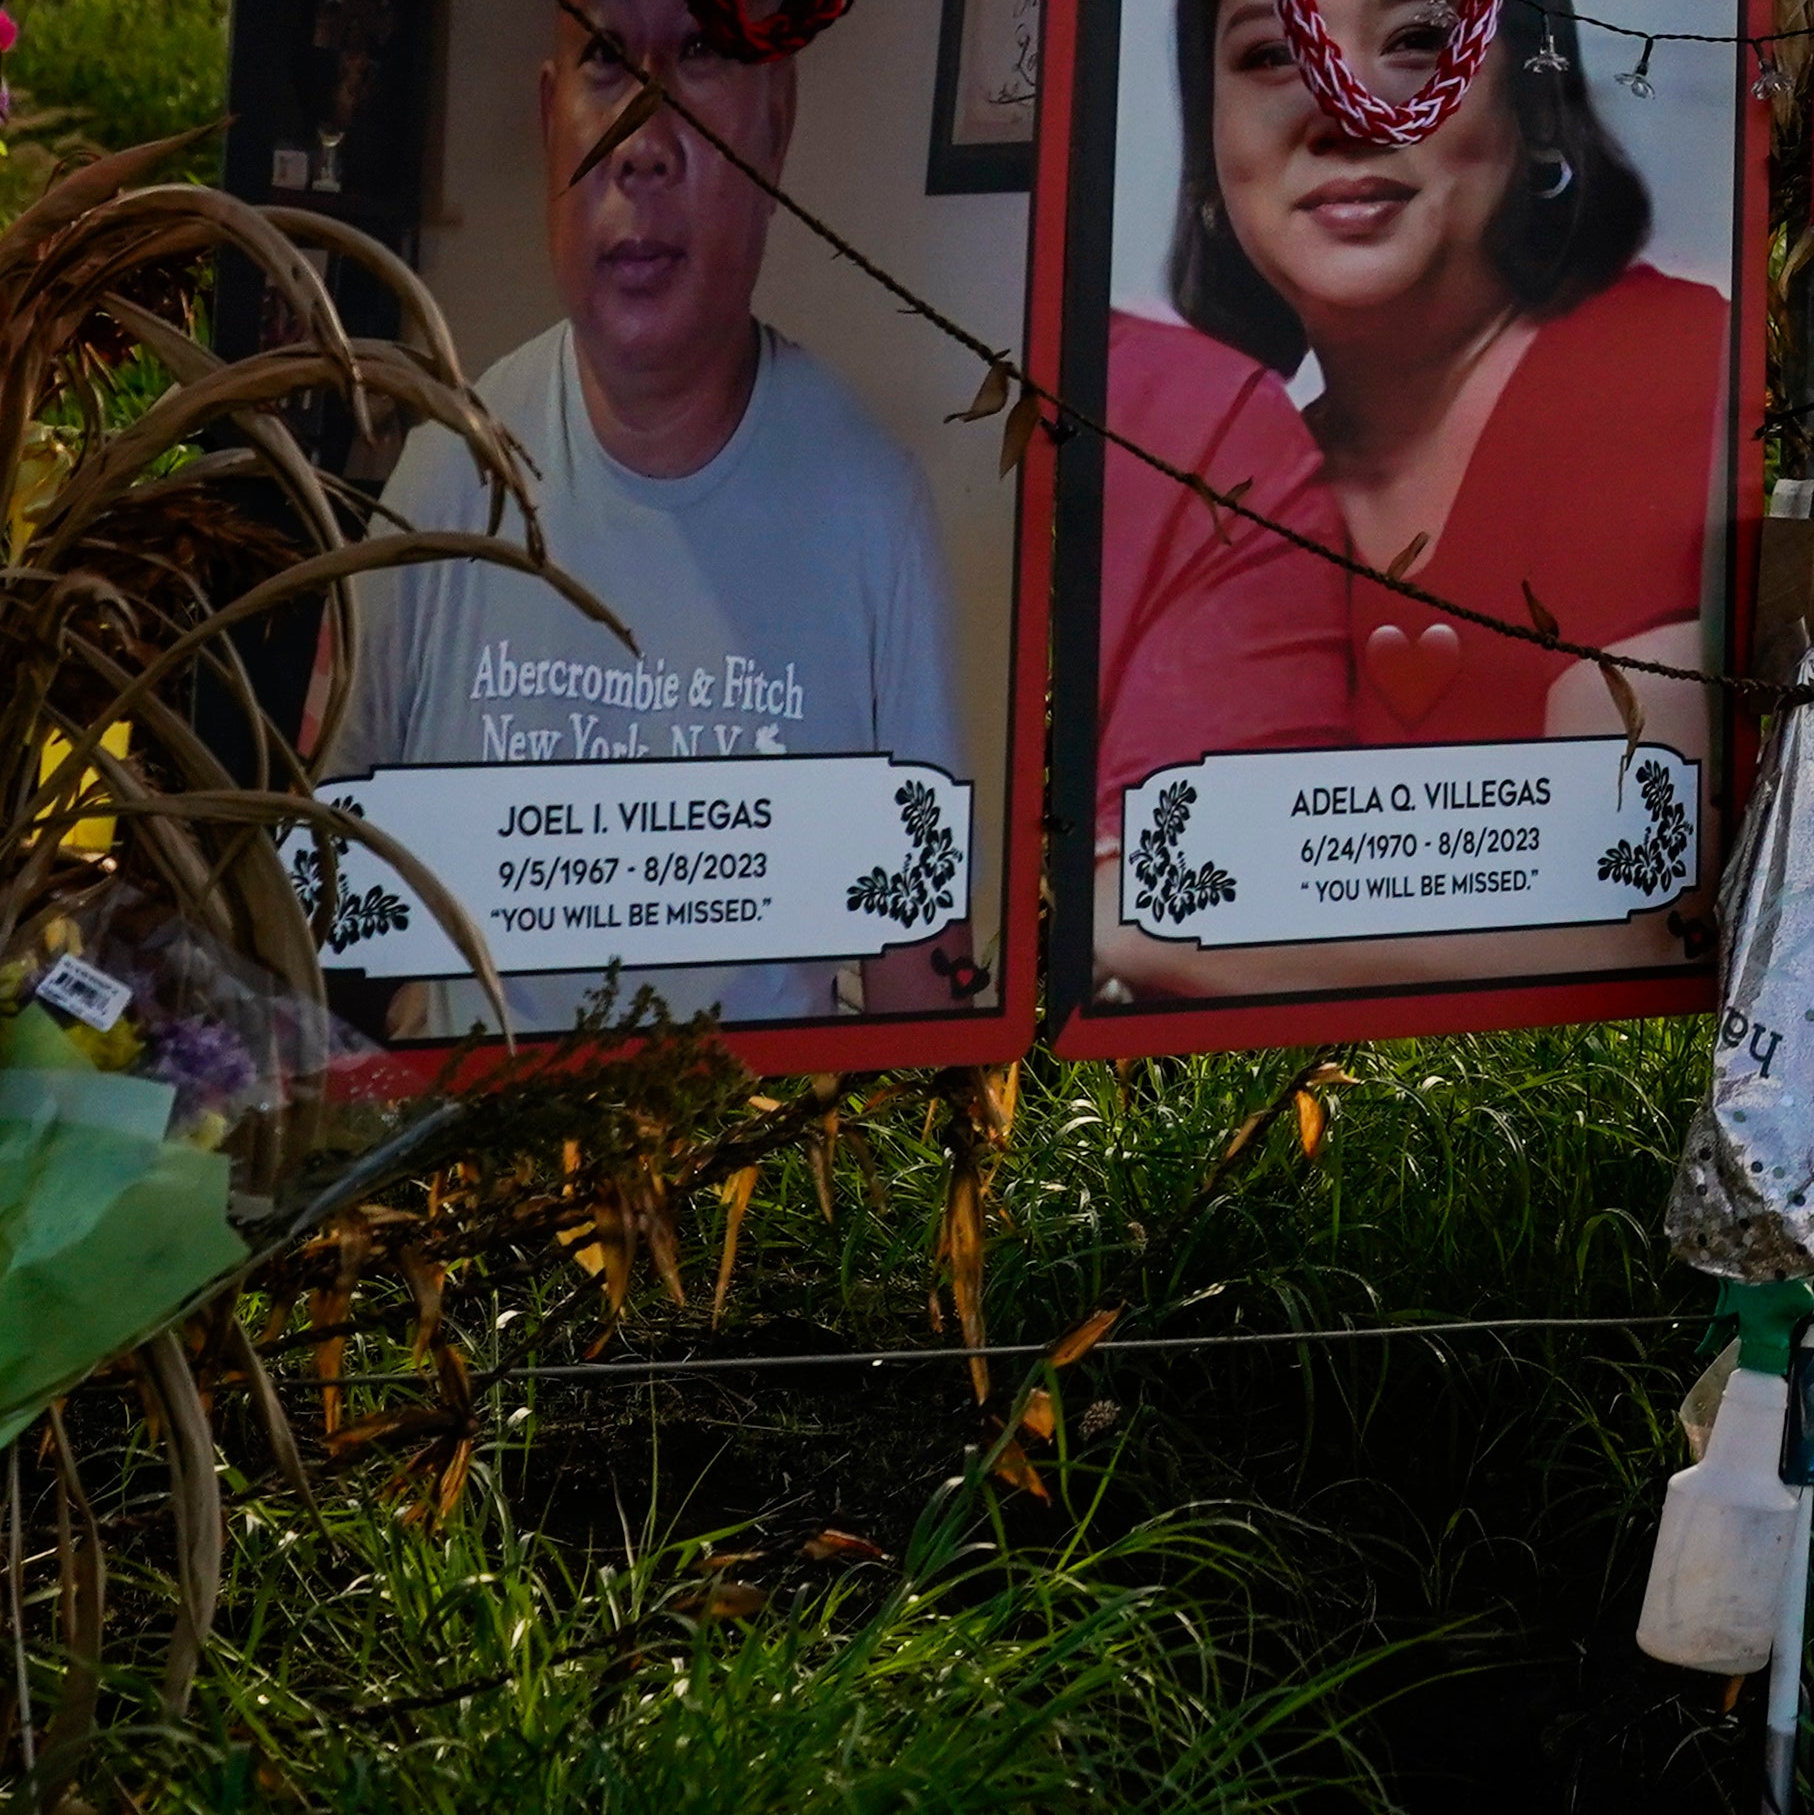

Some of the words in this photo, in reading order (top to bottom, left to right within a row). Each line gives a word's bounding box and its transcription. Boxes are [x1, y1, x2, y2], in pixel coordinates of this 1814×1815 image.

[470, 640, 680, 712] Abercrombie
[688, 666, 716, 708] &
[722, 654, 804, 720] Fitch
[481, 712, 562, 763] New
[498, 803, 584, 837] JOEL
[592, 802, 608, 834] I.
[617, 797, 773, 833] VILLEGAS
[1290, 785, 1384, 818] ADELA
[1390, 783, 1417, 812] Q.
[1424, 776, 1552, 811] VILLEGAS
[1300, 831, 1418, 867] 6/24/1970
[1438, 825, 1541, 859] 8/8/2023
[498, 856, 620, 893] 9/5/1967
[643, 851, 768, 887] 8/8/2023
[1366, 875, 1416, 900] WILL
[1421, 873, 1447, 897] BE
[562, 903, 622, 930] WILL
[628, 901, 660, 927] BE
